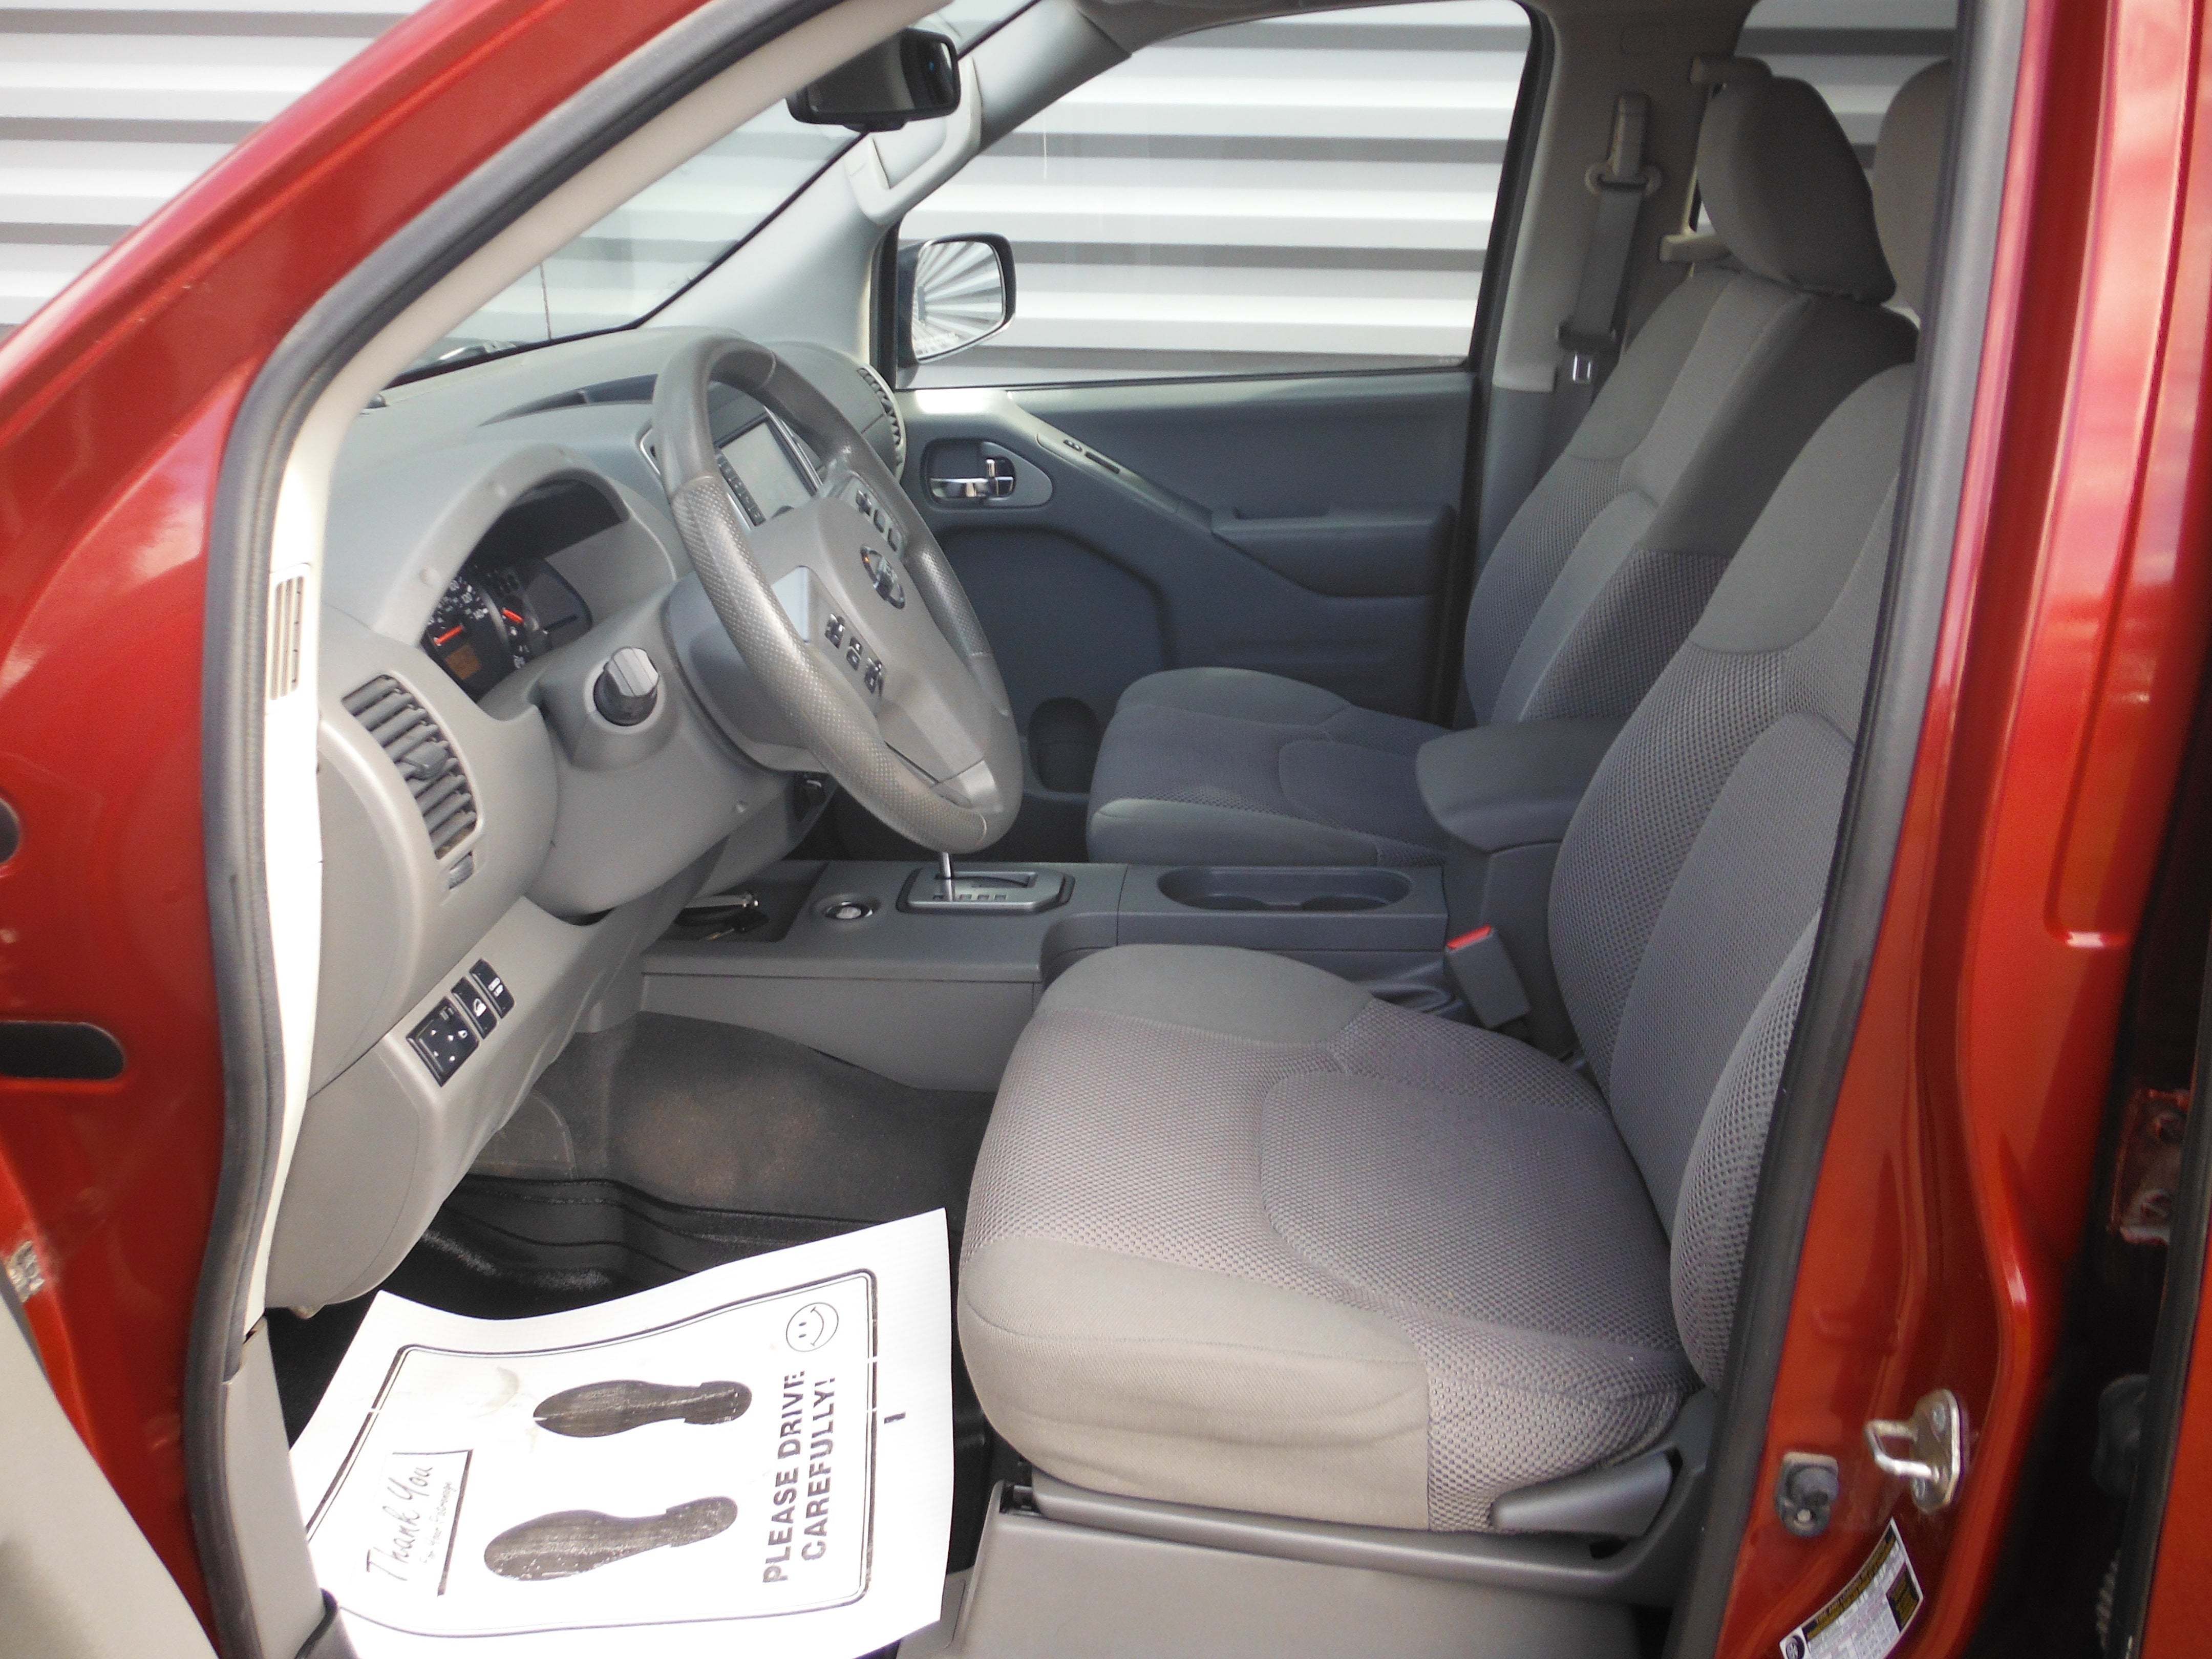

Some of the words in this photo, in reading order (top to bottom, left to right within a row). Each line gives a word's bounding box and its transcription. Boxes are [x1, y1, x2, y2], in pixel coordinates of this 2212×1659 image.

[777, 1370, 805, 1459] DRIVE
[387, 1467, 433, 1500] You
[801, 1377, 835, 1561] CAREFULLY!
[366, 1505, 421, 1581] Thank
[762, 1467, 799, 1583] PLEASE
